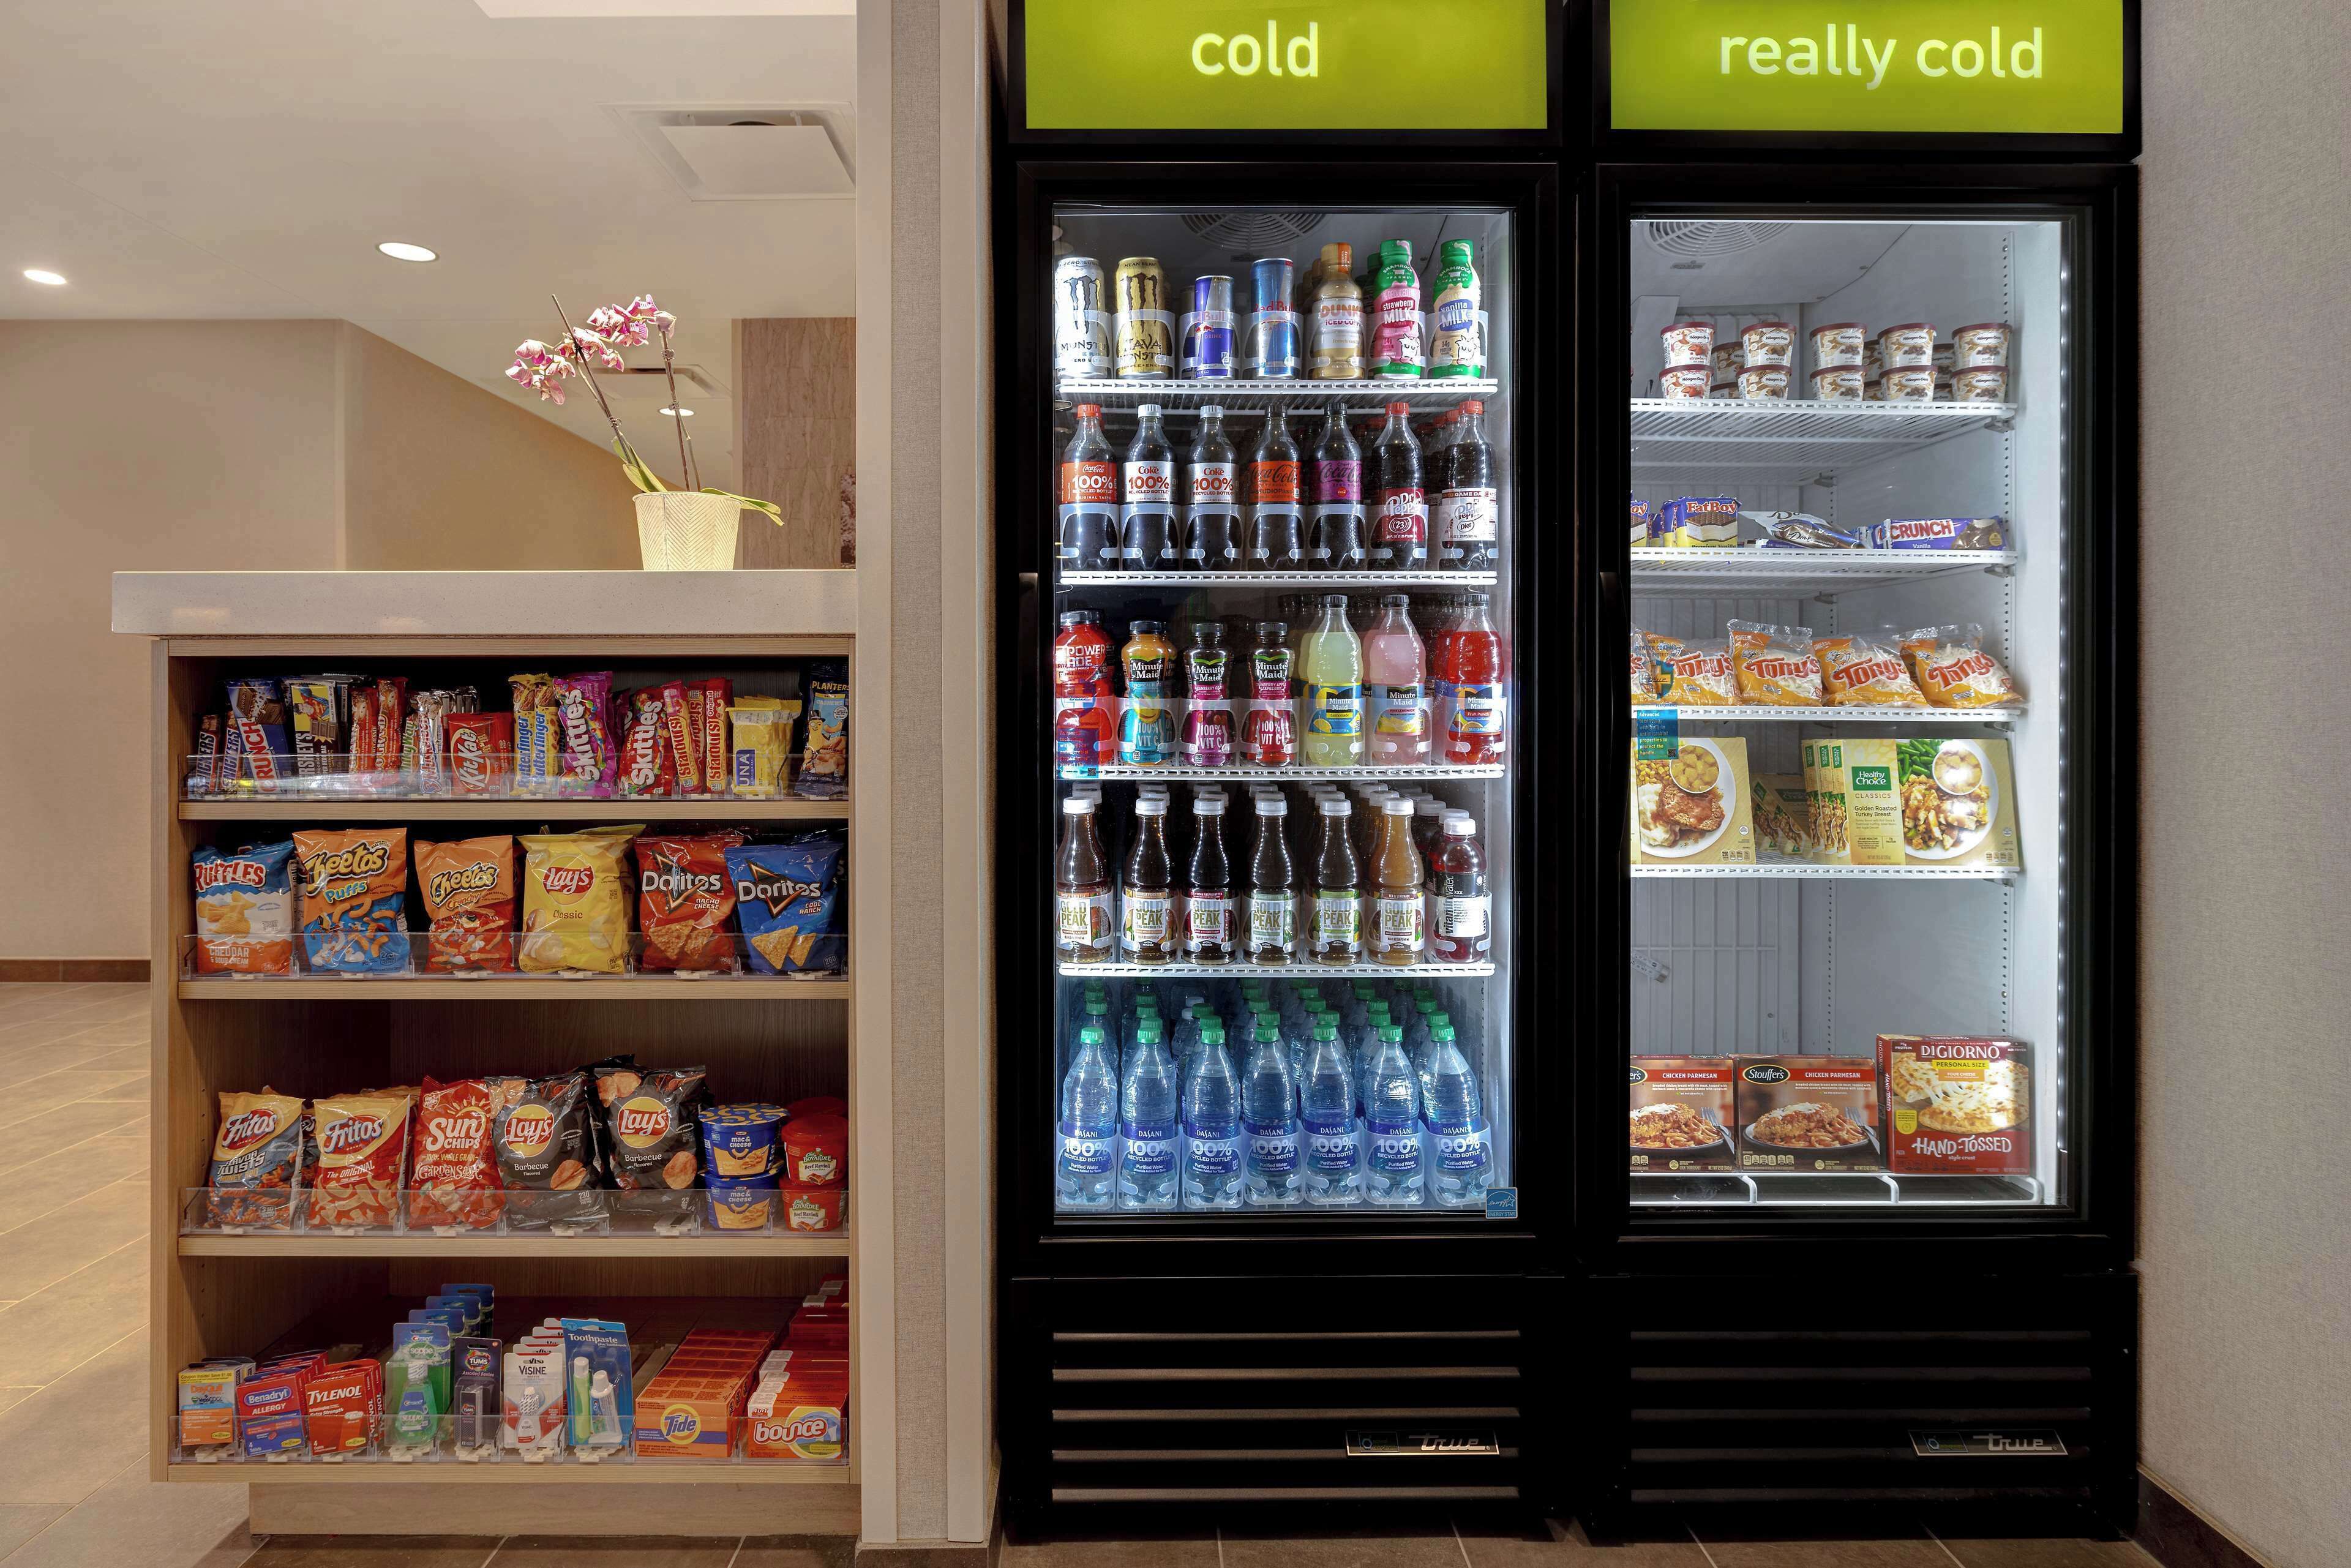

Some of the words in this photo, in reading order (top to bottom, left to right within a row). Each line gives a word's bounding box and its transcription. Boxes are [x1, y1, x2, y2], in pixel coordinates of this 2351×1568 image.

[1190, 21, 1320, 79] cold
[1720, 23, 1895, 90] really
[1916, 26, 2043, 79] cold
[1382, 264, 1413, 273] SHAMROCK
[1439, 266, 1472, 276] SHAMROCK
[1382, 299, 1414, 310] strawberry
[1441, 302, 1468, 311] vanilla
[1384, 307, 1412, 324] MILK
[1138, 465, 1160, 475] Coke
[1203, 467, 1224, 476] Coke
[1071, 475, 1113, 489] 100%
[1128, 476, 1169, 490] 100%
[1193, 478, 1233, 491] 100%
[1400, 492, 1414, 505] Dr
[1686, 501, 1736, 513] FatBoy
[1890, 520, 1952, 540] CRUNCH
[1067, 645, 1105, 656] POWER
[1133, 662, 1163, 671] Minute
[1196, 665, 1224, 674] Minute
[1256, 662, 1287, 671] Minute
[1667, 651, 1734, 677] Tony's
[1745, 656, 1821, 680] Tony's
[1929, 651, 1996, 689] Tony's
[1136, 670, 1160, 678] Maid
[1259, 670, 1283, 679] Maid
[812, 680, 849, 691] PLANTERS
[565, 689, 600, 782] Skittles
[631, 701, 662, 786] Skittles
[1138, 735, 1154, 747] VIT
[1199, 737, 1215, 749] VIT
[1261, 734, 1275, 745] VIT
[517, 715, 533, 786] Butterfinger
[533, 710, 549, 784] Butterfinger
[669, 719, 693, 778] Starburst
[707, 719, 721, 781] Starburst
[245, 721, 277, 792] CRUNCH
[195, 861, 266, 891] RUFFLES
[304, 841, 390, 897] Cheetos
[430, 861, 500, 907] Cheetos
[546, 866, 590, 895] Lay's
[643, 871, 721, 891] Doritos
[323, 880, 369, 903] Puffs
[738, 880, 822, 902] Doritos
[445, 892, 481, 910] Crunchy
[553, 910, 583, 919] Classic
[209, 946, 250, 956] CHEDDAR
[1749, 1068, 1784, 1081] Stouffer's
[221, 1112, 278, 1148] Fritos
[508, 1117, 553, 1145] Lay's
[620, 1110, 669, 1136] Lay's
[323, 1117, 384, 1153] Fritos
[444, 1137, 481, 1149] CHIPS
[1310, 1137, 1353, 1151] 100%
[1378, 1138, 1418, 1152] 100%
[1911, 1135, 2012, 1157] HAND-TOSSED
[217, 1152, 266, 1176] TWISTS
[624, 1153, 662, 1162] Barbecue
[340, 1162, 375, 1178] ORIGINAL
[568, 1334, 618, 1344] Toothpaste
[519, 1365, 547, 1375] VISINE
[247, 1389, 290, 1404] Benadryl
[307, 1386, 362, 1405] TYLENOL
[252, 1403, 286, 1415] ALLERGY
[664, 1414, 697, 1436] Tide
[755, 1419, 827, 1444] bounce
[1409, 1433, 1486, 1450] true
[1973, 1433, 2052, 1450] true
